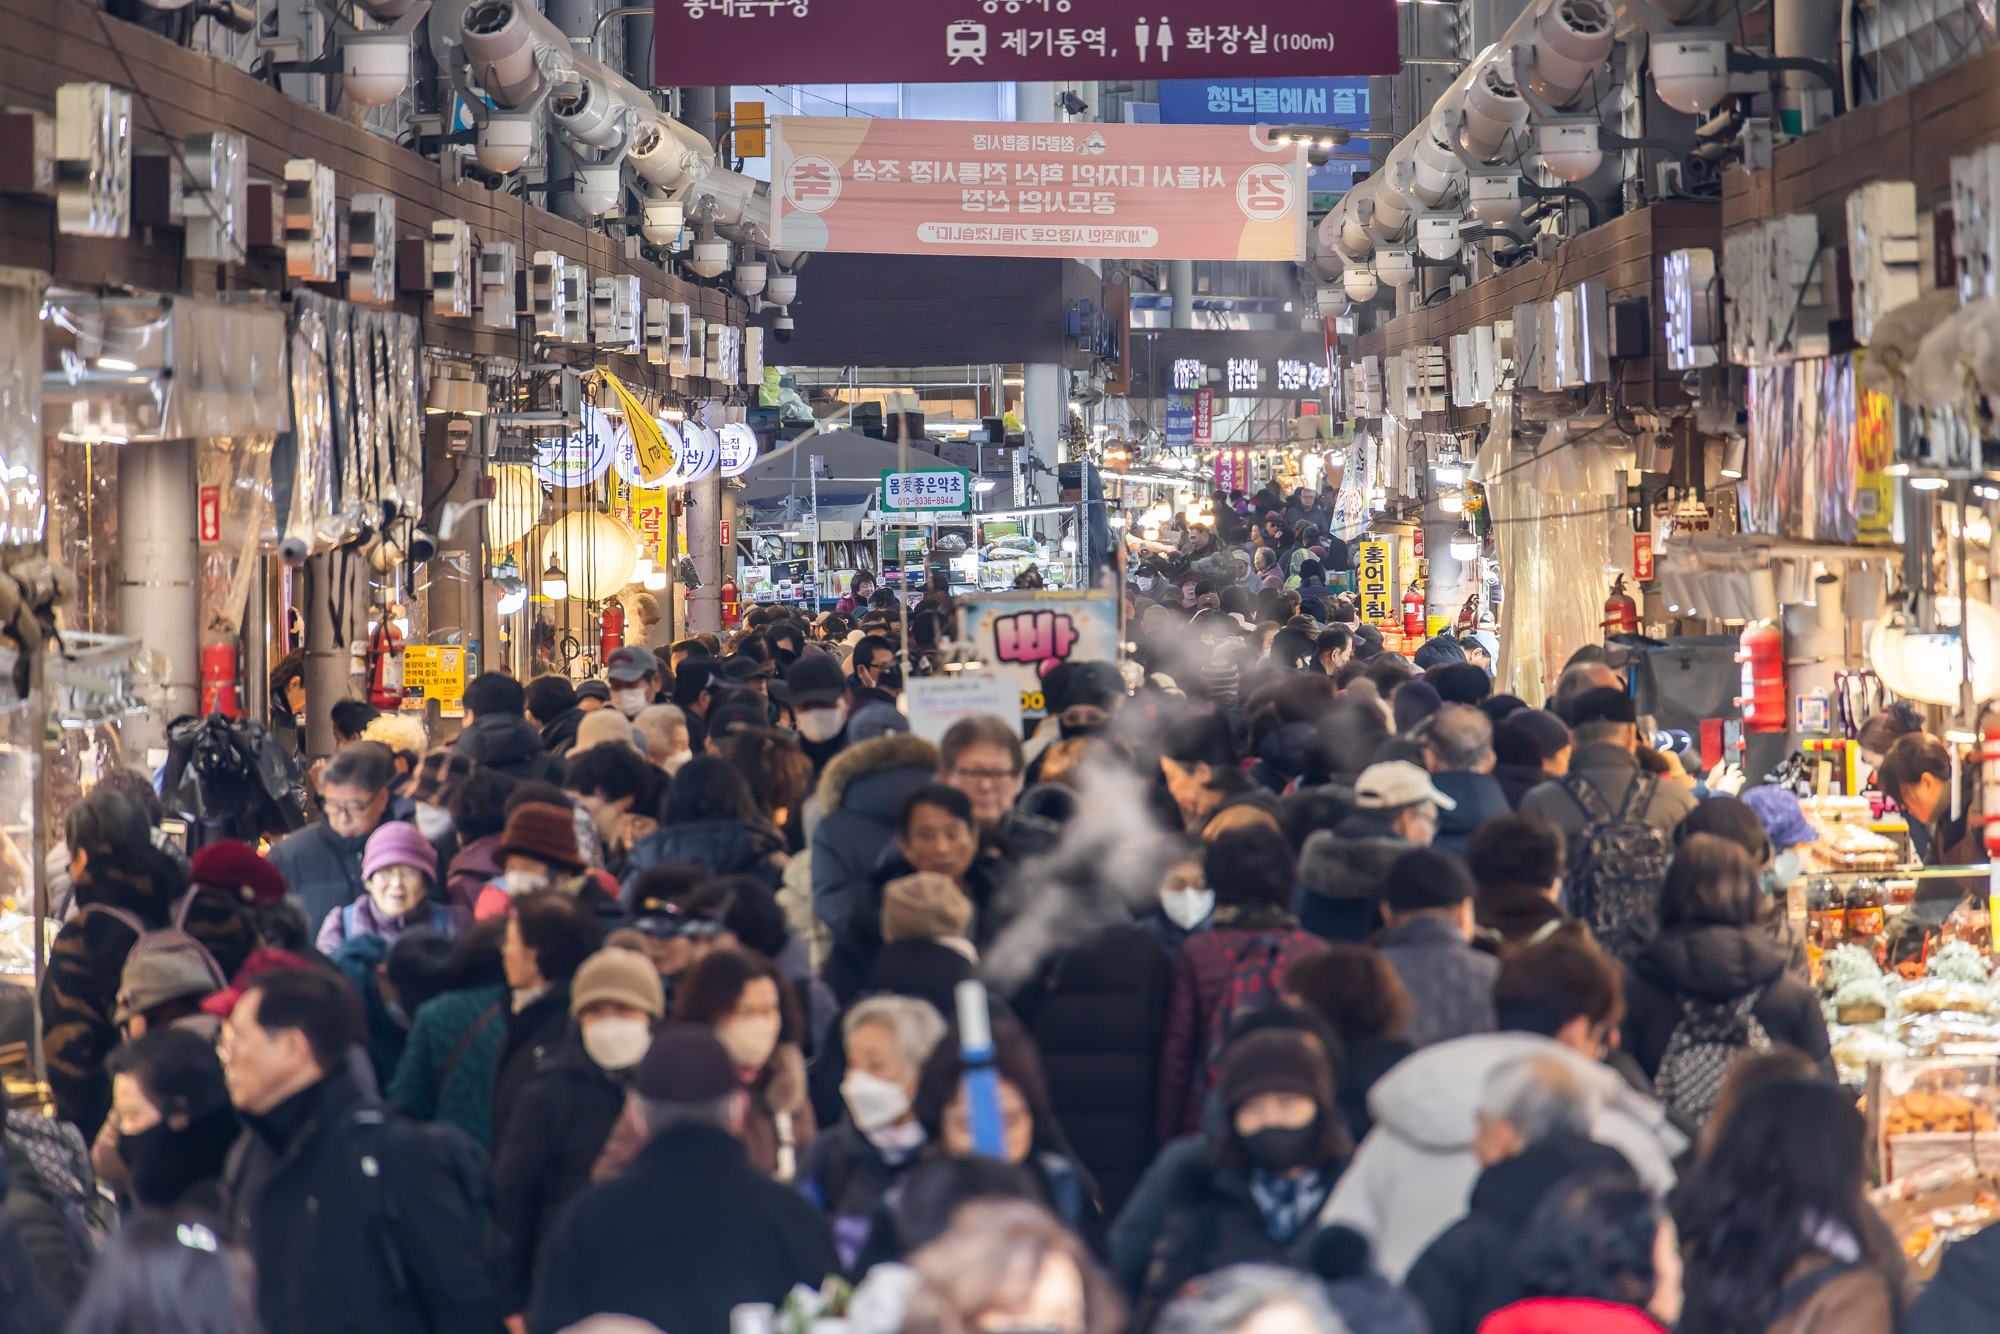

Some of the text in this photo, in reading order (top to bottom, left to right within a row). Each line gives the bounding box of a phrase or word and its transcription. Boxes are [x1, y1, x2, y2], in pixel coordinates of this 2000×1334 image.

[1000, 24, 1334, 57] 제기동역, 화장실 (100m)
[1207, 85, 1327, 114] 청년몰에서
[897, 495, 954, 506] 010-5336-8944
[1363, 546, 1387, 619] 홍어무침
